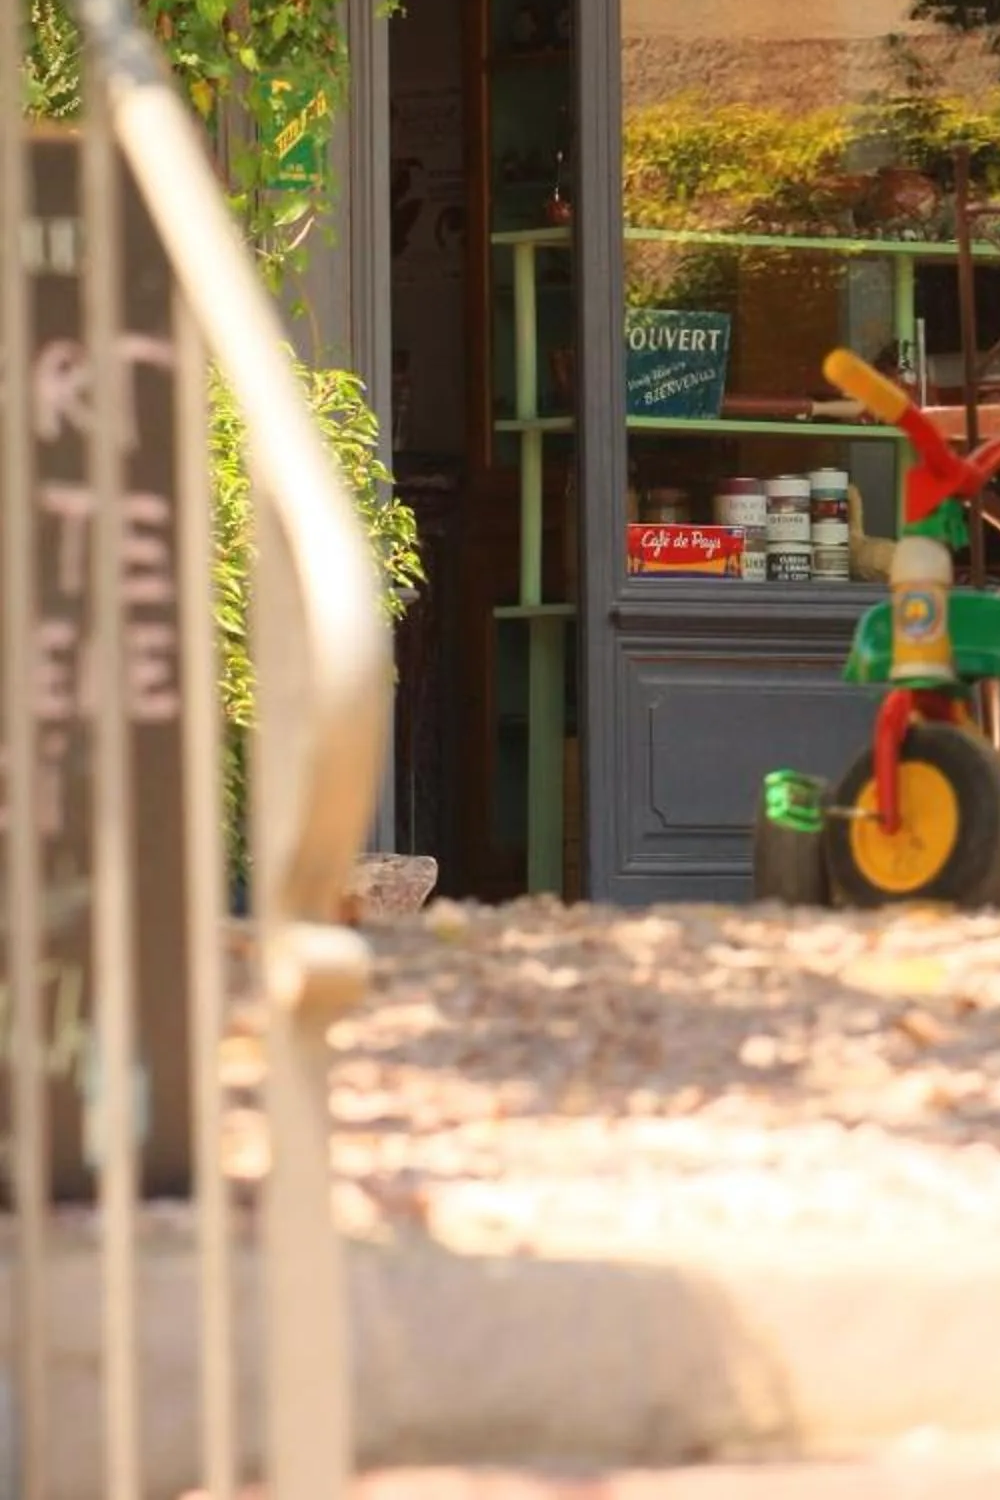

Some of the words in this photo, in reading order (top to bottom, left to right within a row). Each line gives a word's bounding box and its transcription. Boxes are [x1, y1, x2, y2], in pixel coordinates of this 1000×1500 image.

[629, 326, 723, 352] OUVERT
[640, 529, 671, 558] Café
[672, 531, 690, 549] de
[691, 530, 722, 559] Pays
